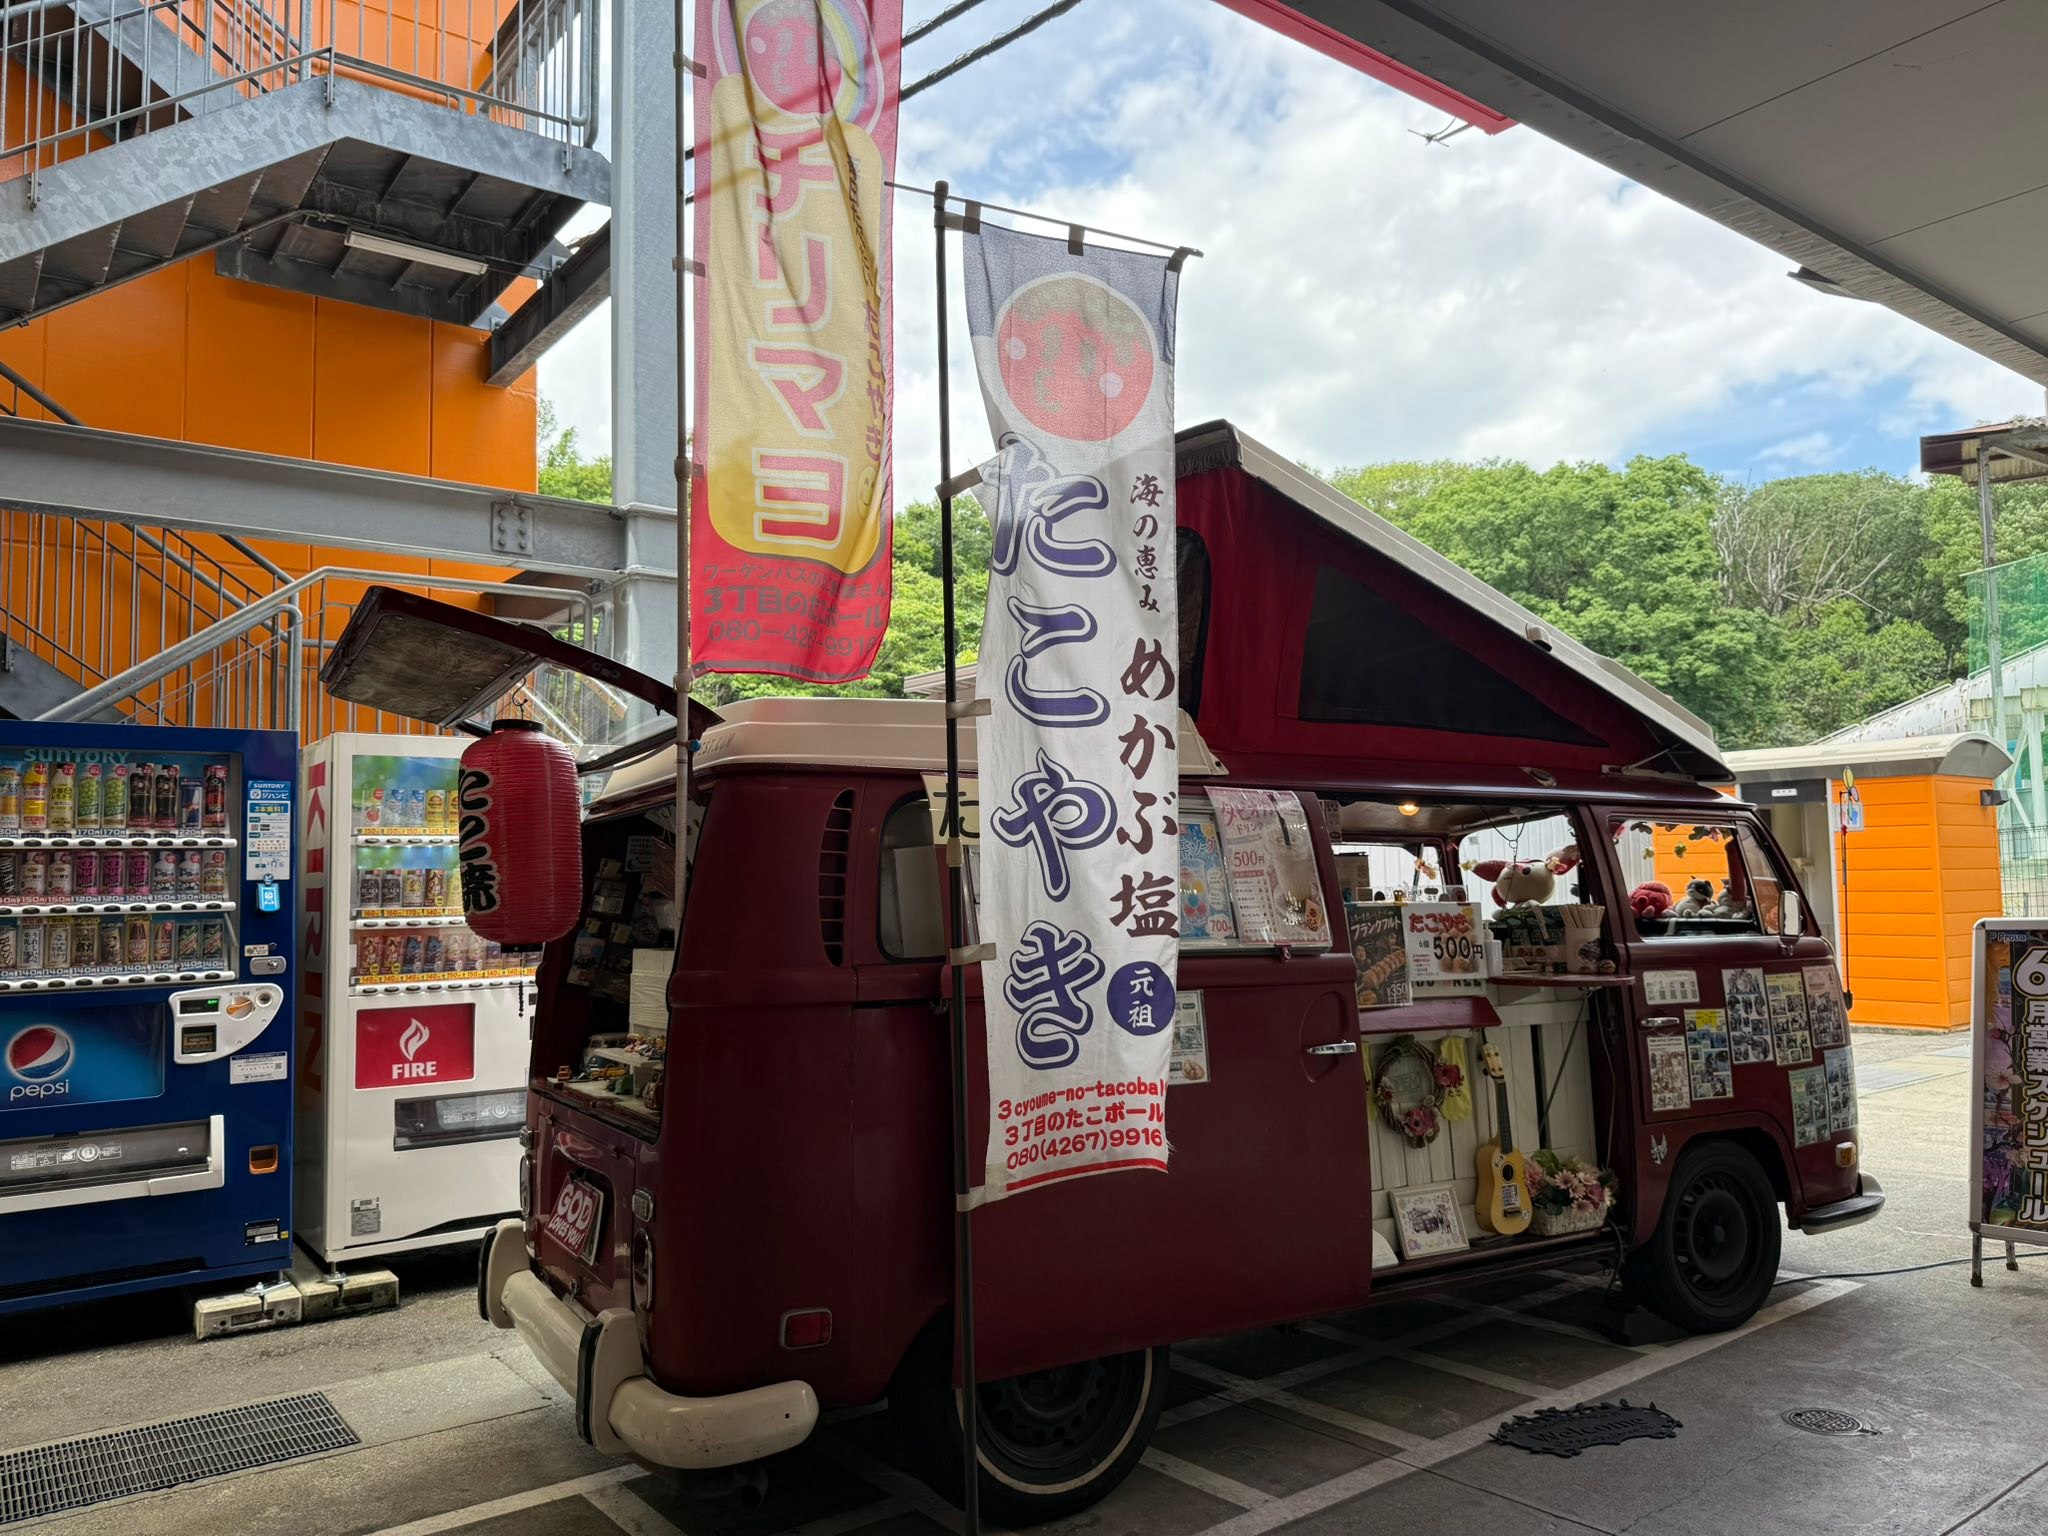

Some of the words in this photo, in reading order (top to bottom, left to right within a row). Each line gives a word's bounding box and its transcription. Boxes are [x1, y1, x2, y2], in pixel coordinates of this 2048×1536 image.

[1130, 473, 1164, 613] 海の恵み
[23, 748, 130, 764] SUNTORY
[991, 432, 1118, 1070] たこやき
[1109, 637, 1179, 938] めかぶ塩
[1234, 850, 1265, 868] 500円
[303, 759, 327, 1093] KIRIN
[1351, 916, 1402, 943] フランクフルト
[1408, 911, 1472, 934] たこやき
[1998, 932, 2027, 943] Prova
[1433, 936, 1484, 960] 500円
[1127, 967, 1156, 1030] 元祖
[391, 1061, 438, 1080] FIRE
[10, 1079, 69, 1101] pepsi
[1005, 1100, 1164, 1146] 3丁目のたこボール
[1007, 1127, 1163, 1170] 080(4267)9916
[557, 1183, 593, 1230] GOD
[547, 1213, 570, 1238] LOVES
[564, 1224, 586, 1250] YOU!
